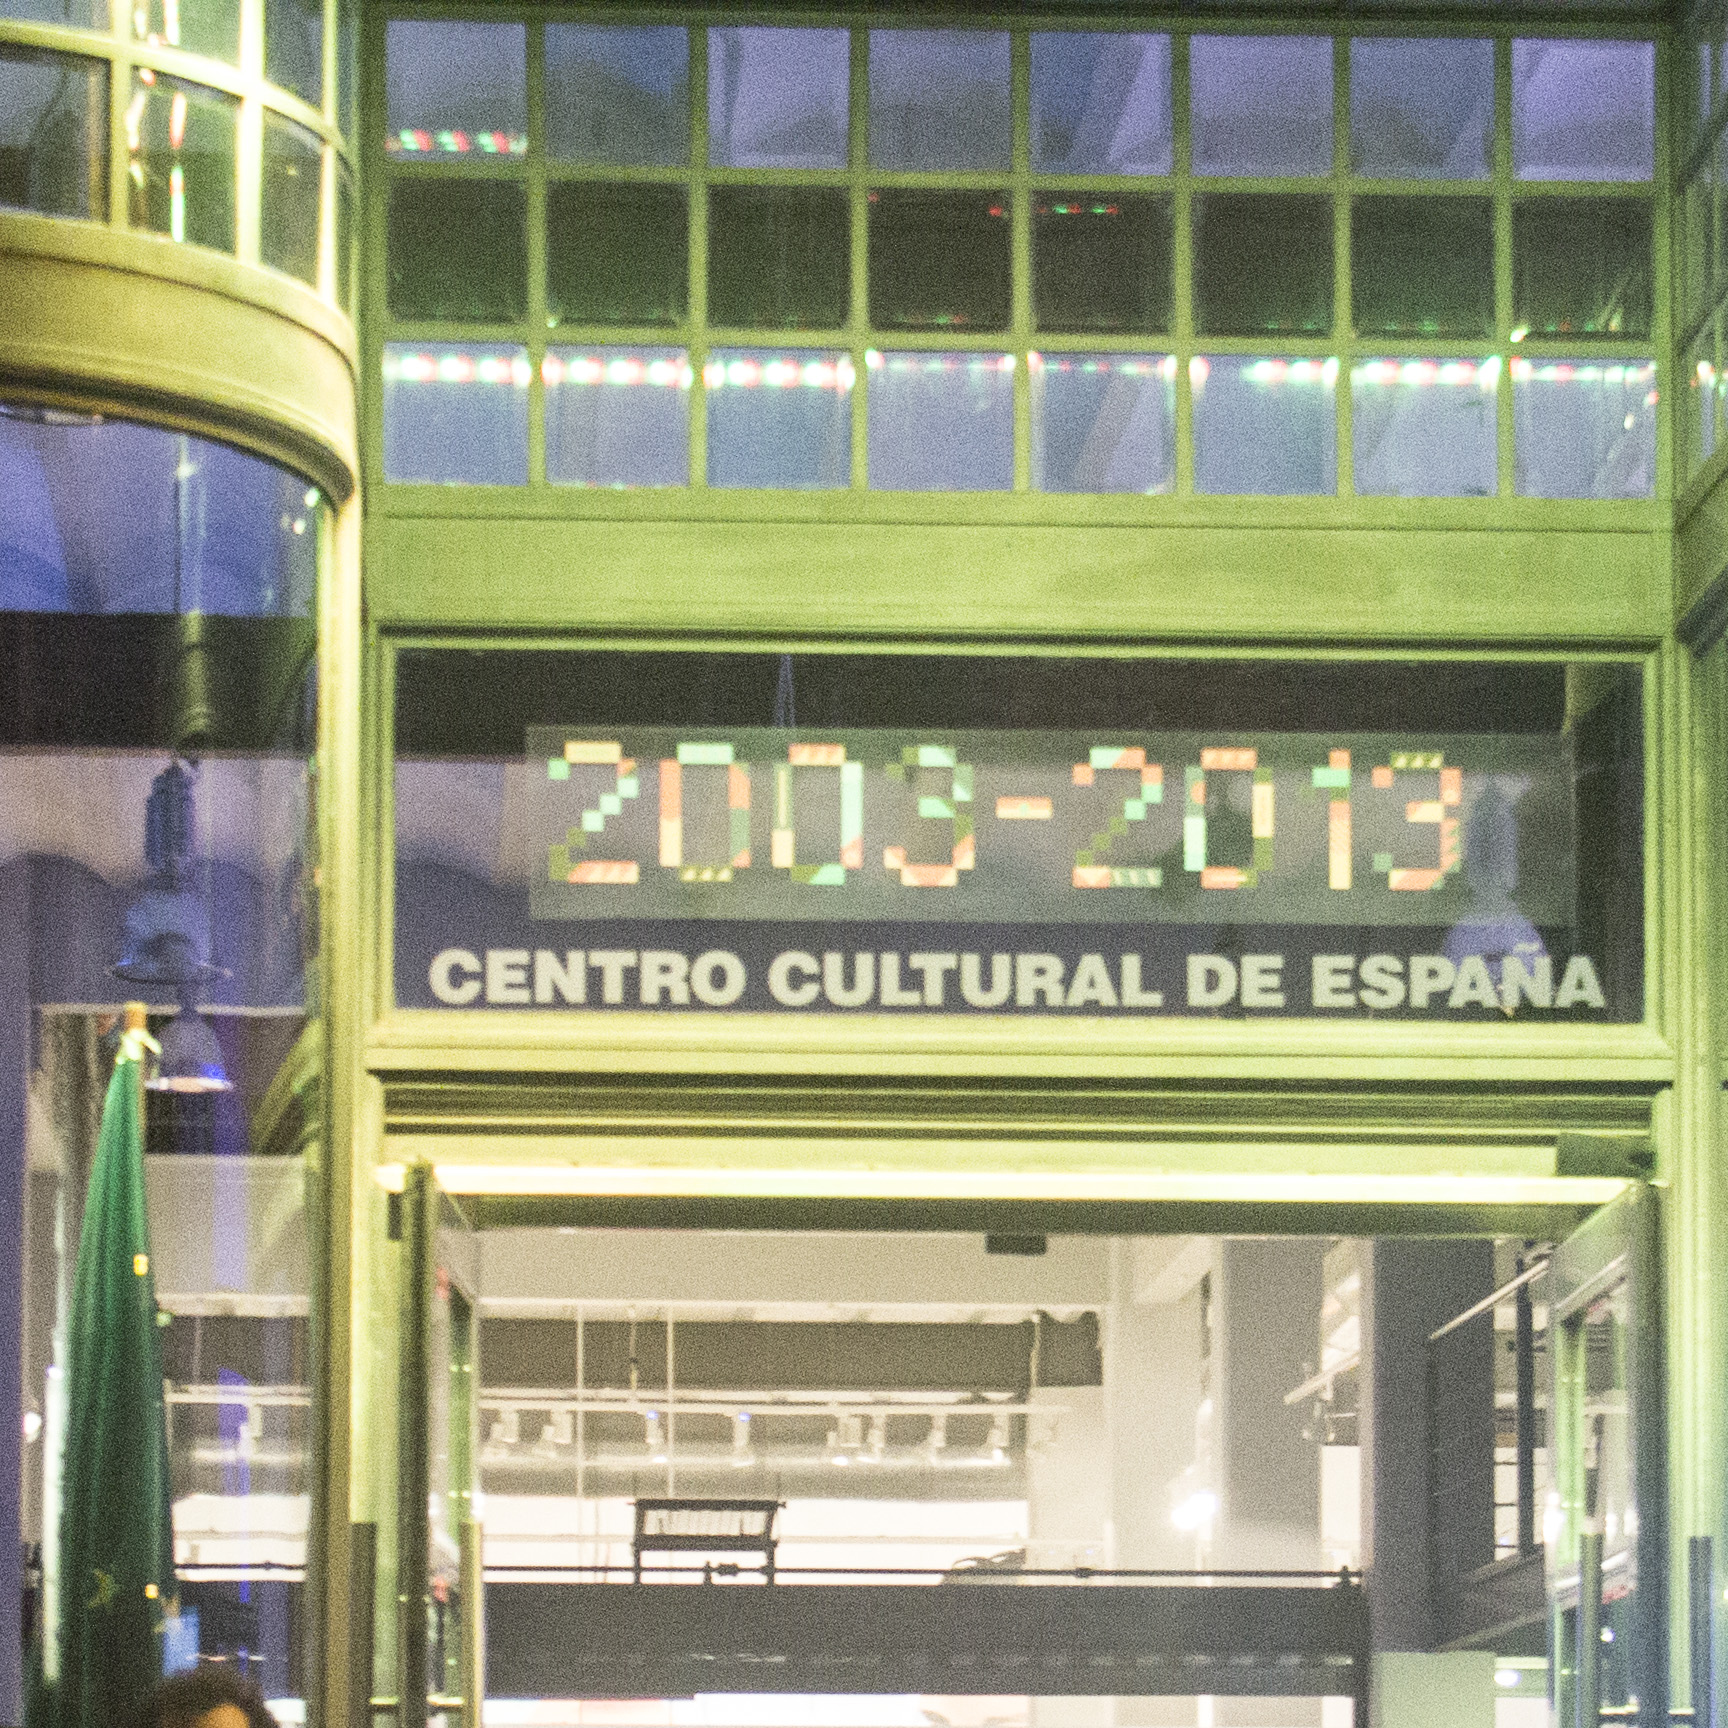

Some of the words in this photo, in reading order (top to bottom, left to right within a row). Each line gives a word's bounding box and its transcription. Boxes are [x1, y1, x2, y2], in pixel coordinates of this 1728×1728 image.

[546, 740, 1465, 892] 2003-2013
[428, 947, 748, 1007] CENTRO
[767, 949, 1165, 1009] CULTURAL
[1185, 953, 1286, 1009] DE
[1310, 941, 1607, 1010] ESPAÑA
